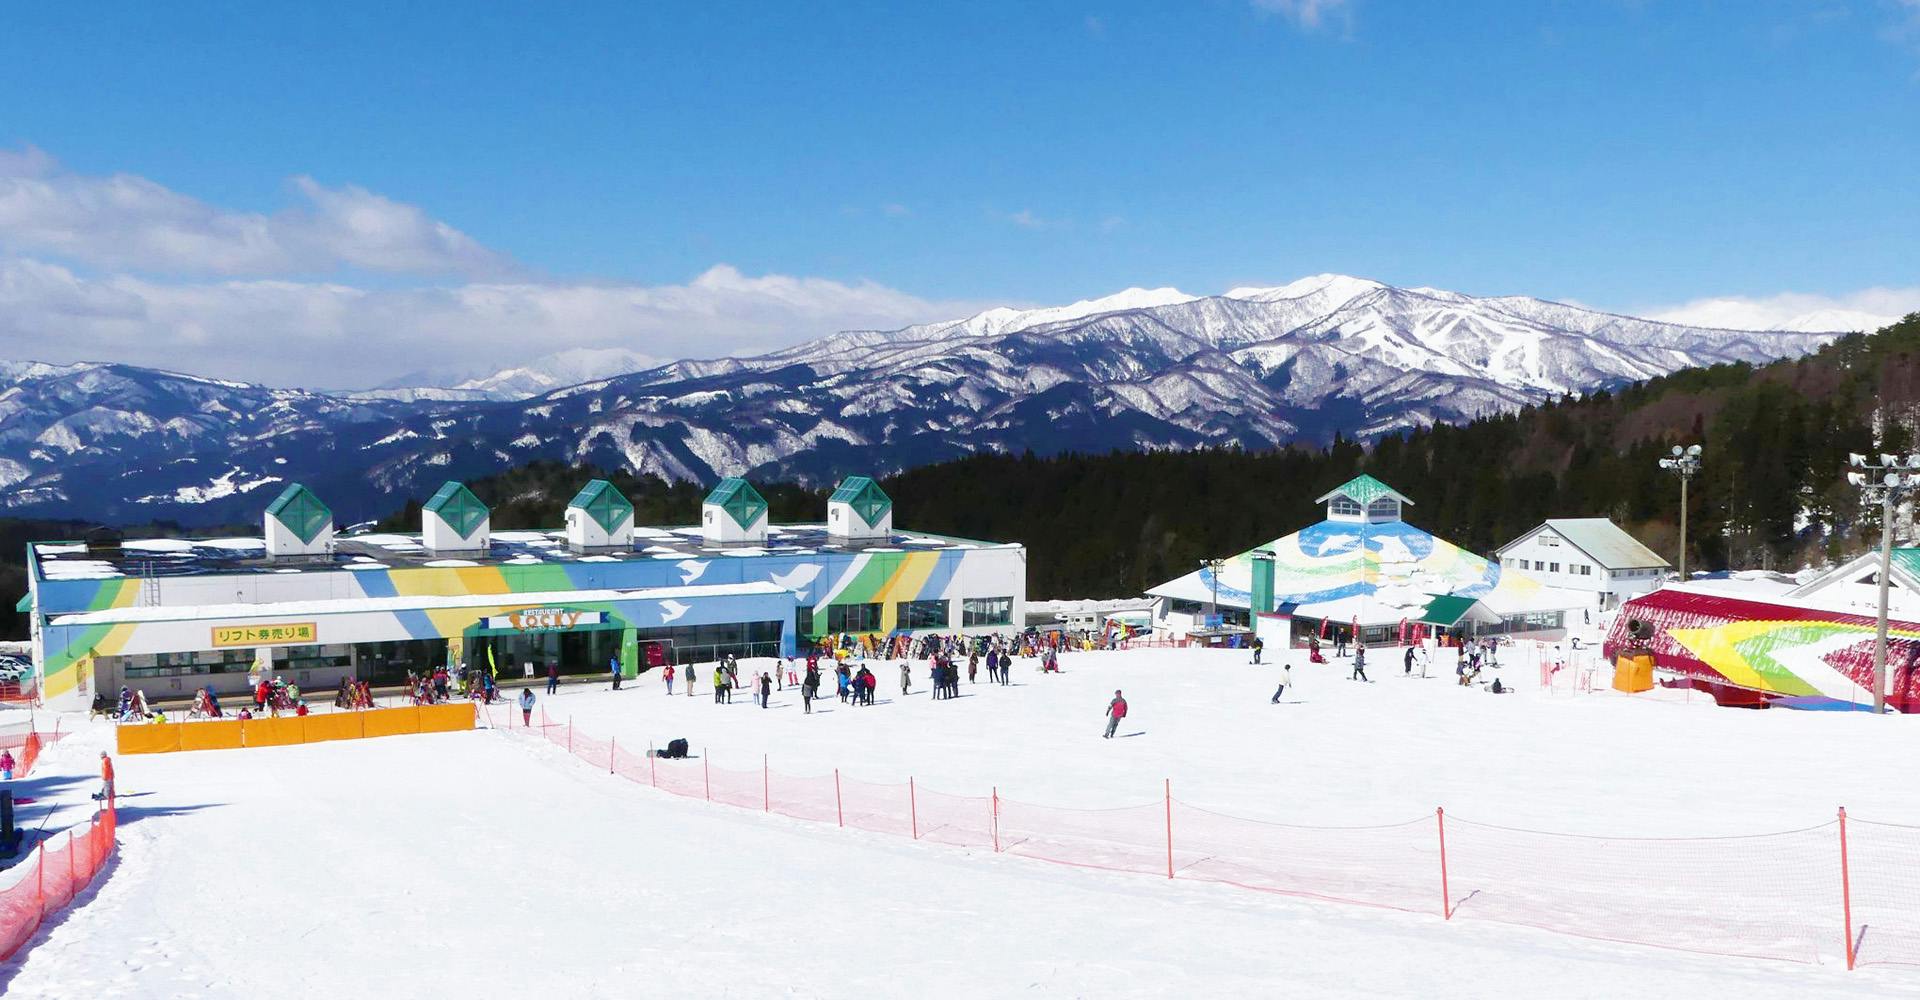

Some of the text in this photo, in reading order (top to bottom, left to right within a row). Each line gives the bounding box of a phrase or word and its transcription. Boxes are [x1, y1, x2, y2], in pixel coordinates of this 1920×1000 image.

[523, 608, 565, 616] RESTAURANT
[219, 627, 310, 641] リフト券売り場
